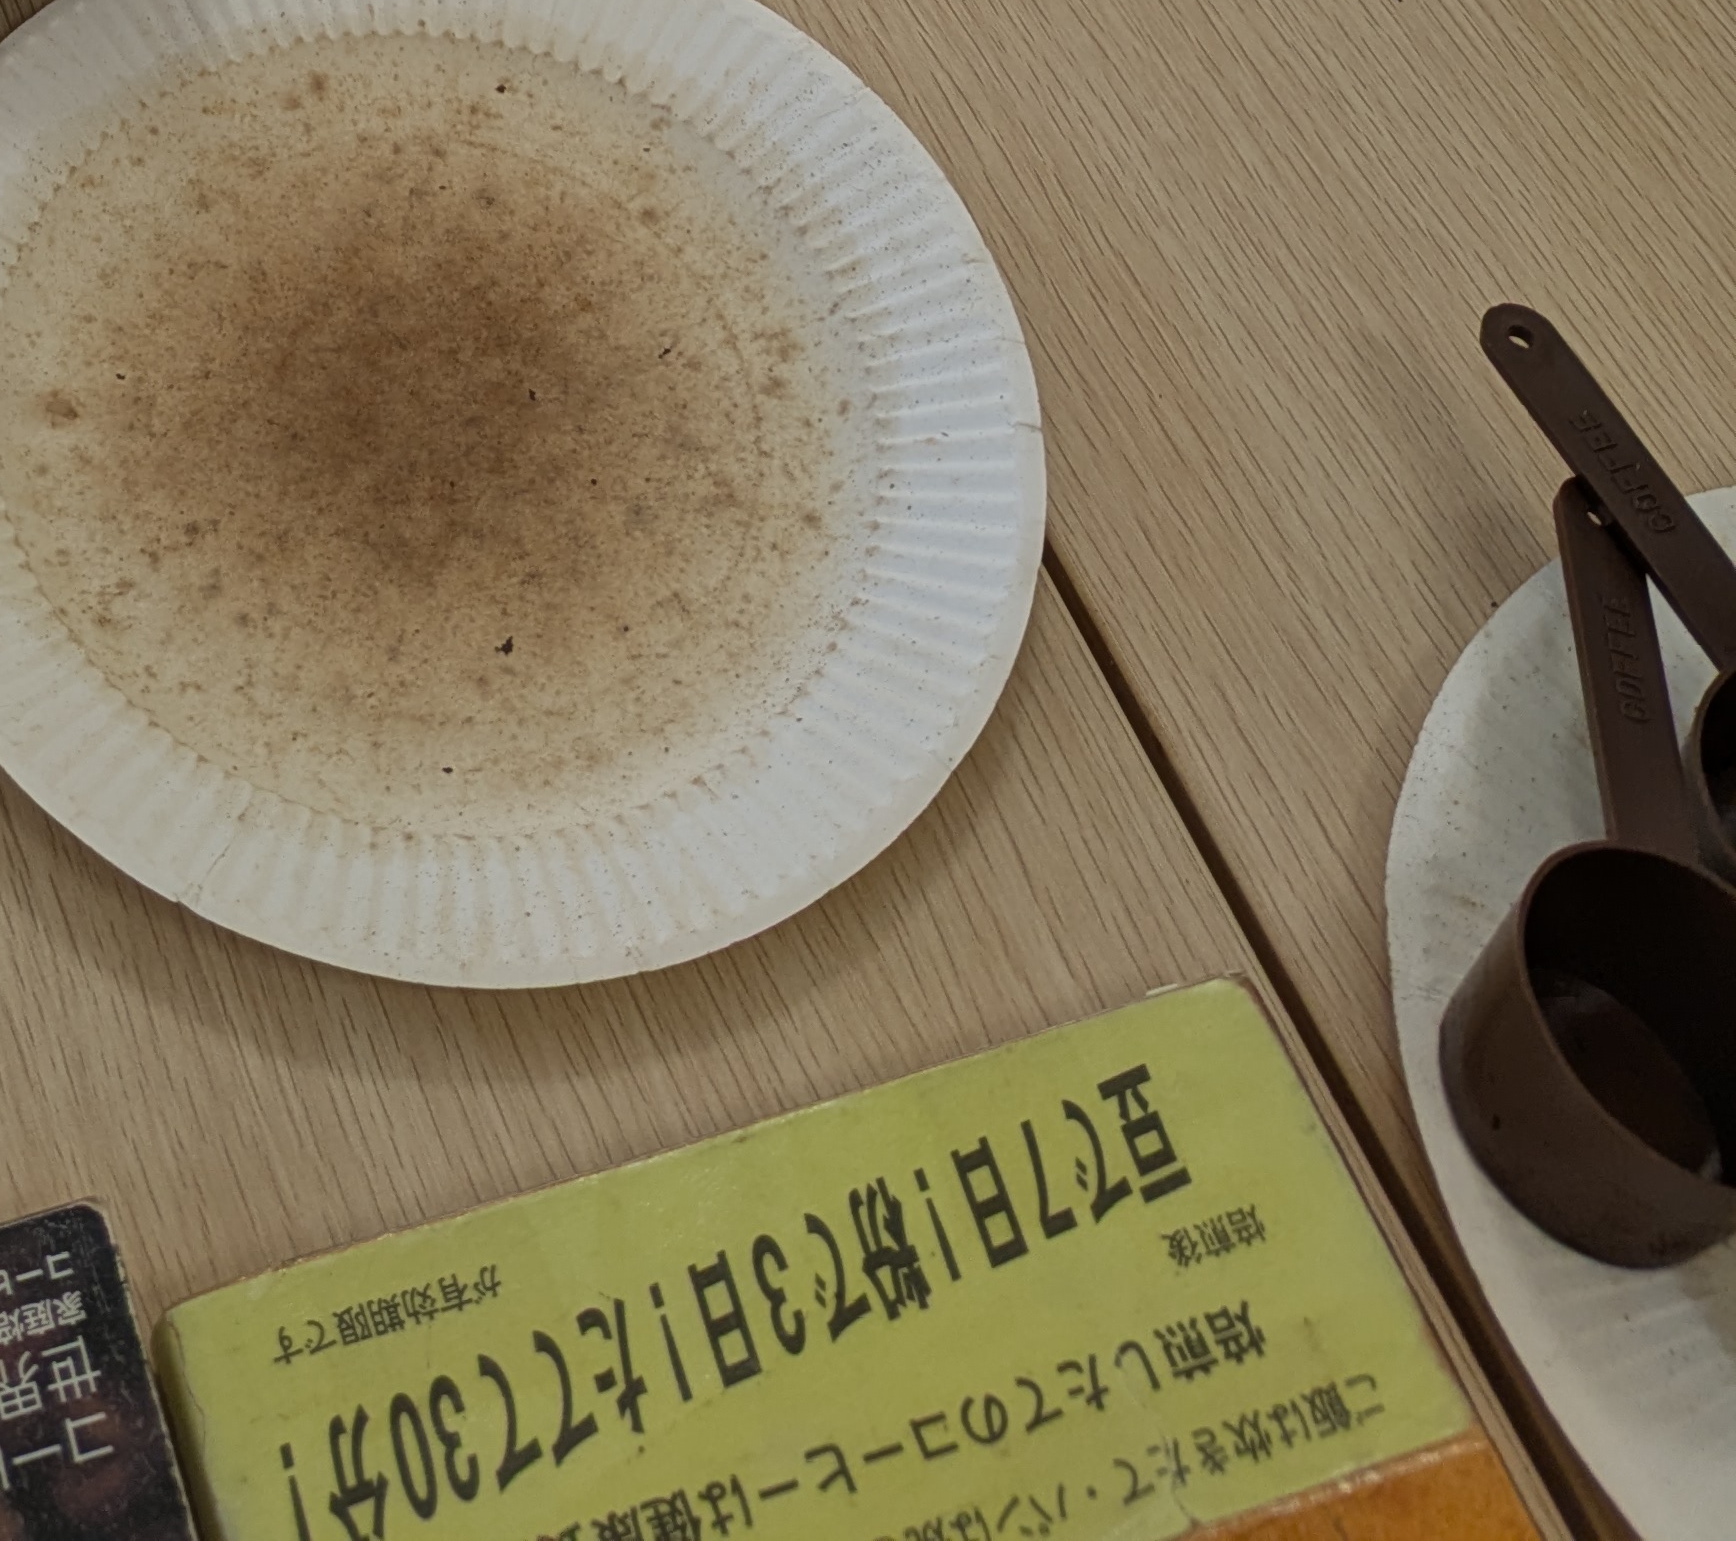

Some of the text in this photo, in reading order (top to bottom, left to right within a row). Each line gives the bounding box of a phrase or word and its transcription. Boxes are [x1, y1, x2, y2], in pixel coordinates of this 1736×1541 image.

[1568, 409, 1677, 533] COFFEE
[1602, 596, 1650, 723] COFFEE
[1158, 1203, 1267, 1273] 焙煎後
[268, 1263, 503, 1366] が有効期限です
